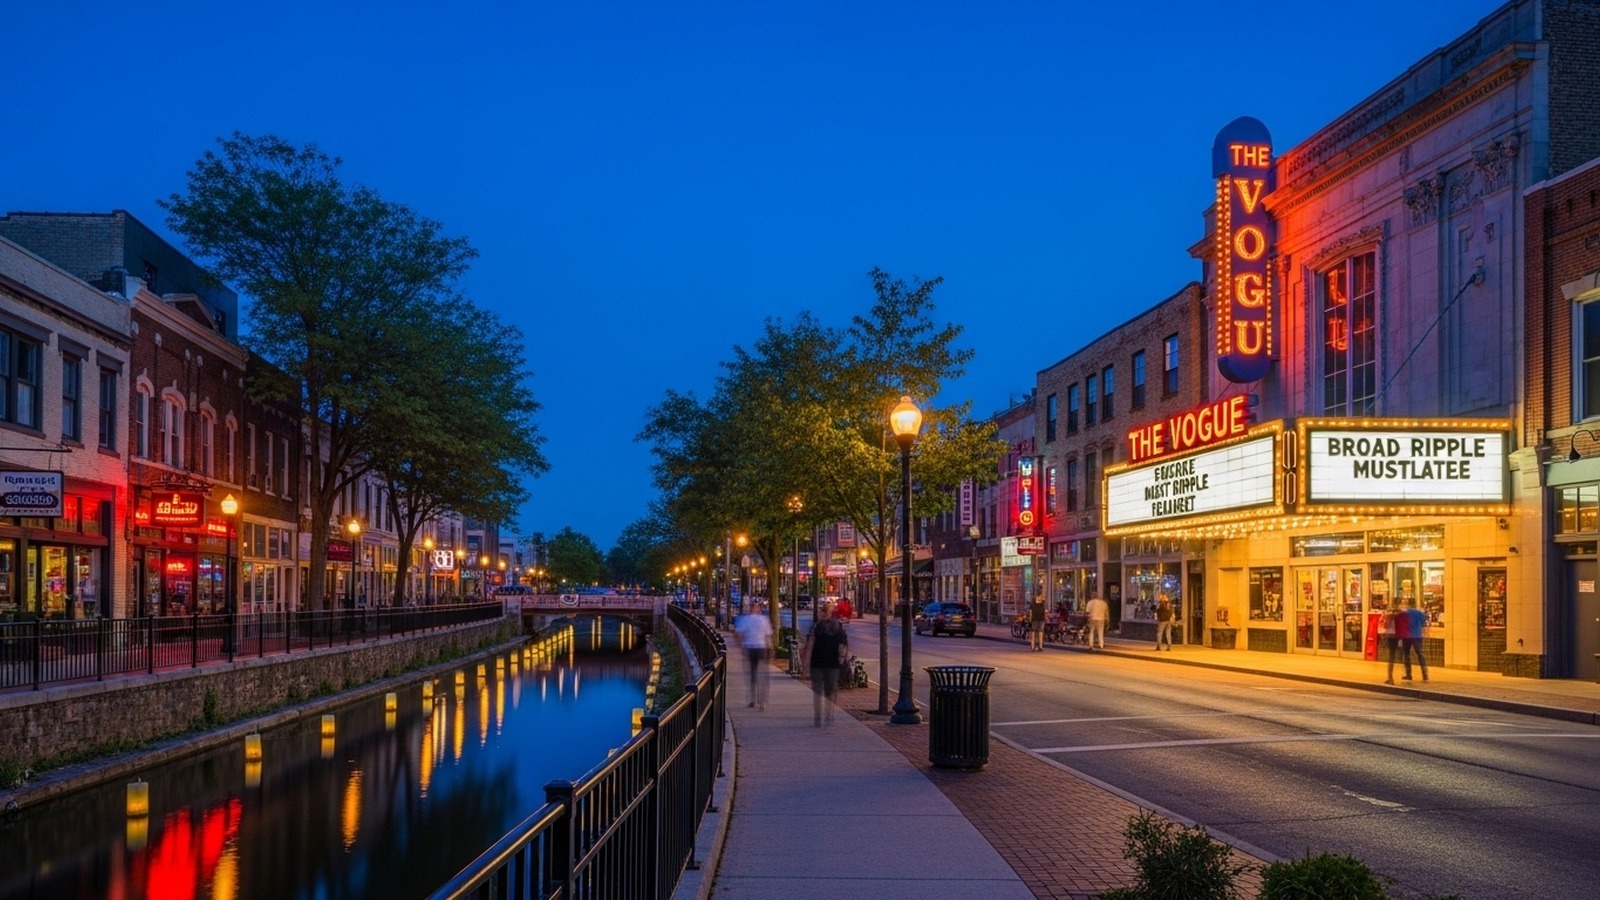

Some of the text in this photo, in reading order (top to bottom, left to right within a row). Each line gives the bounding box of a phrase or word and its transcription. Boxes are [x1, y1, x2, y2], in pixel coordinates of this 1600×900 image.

[1230, 144, 1270, 167] THE
[1233, 179, 1265, 355] VOGU
[1128, 395, 1245, 460] THE VOGUE
[1328, 437, 1486, 458] BROAD RIPPLE
[1353, 460, 1471, 480] MUSTLATEE
